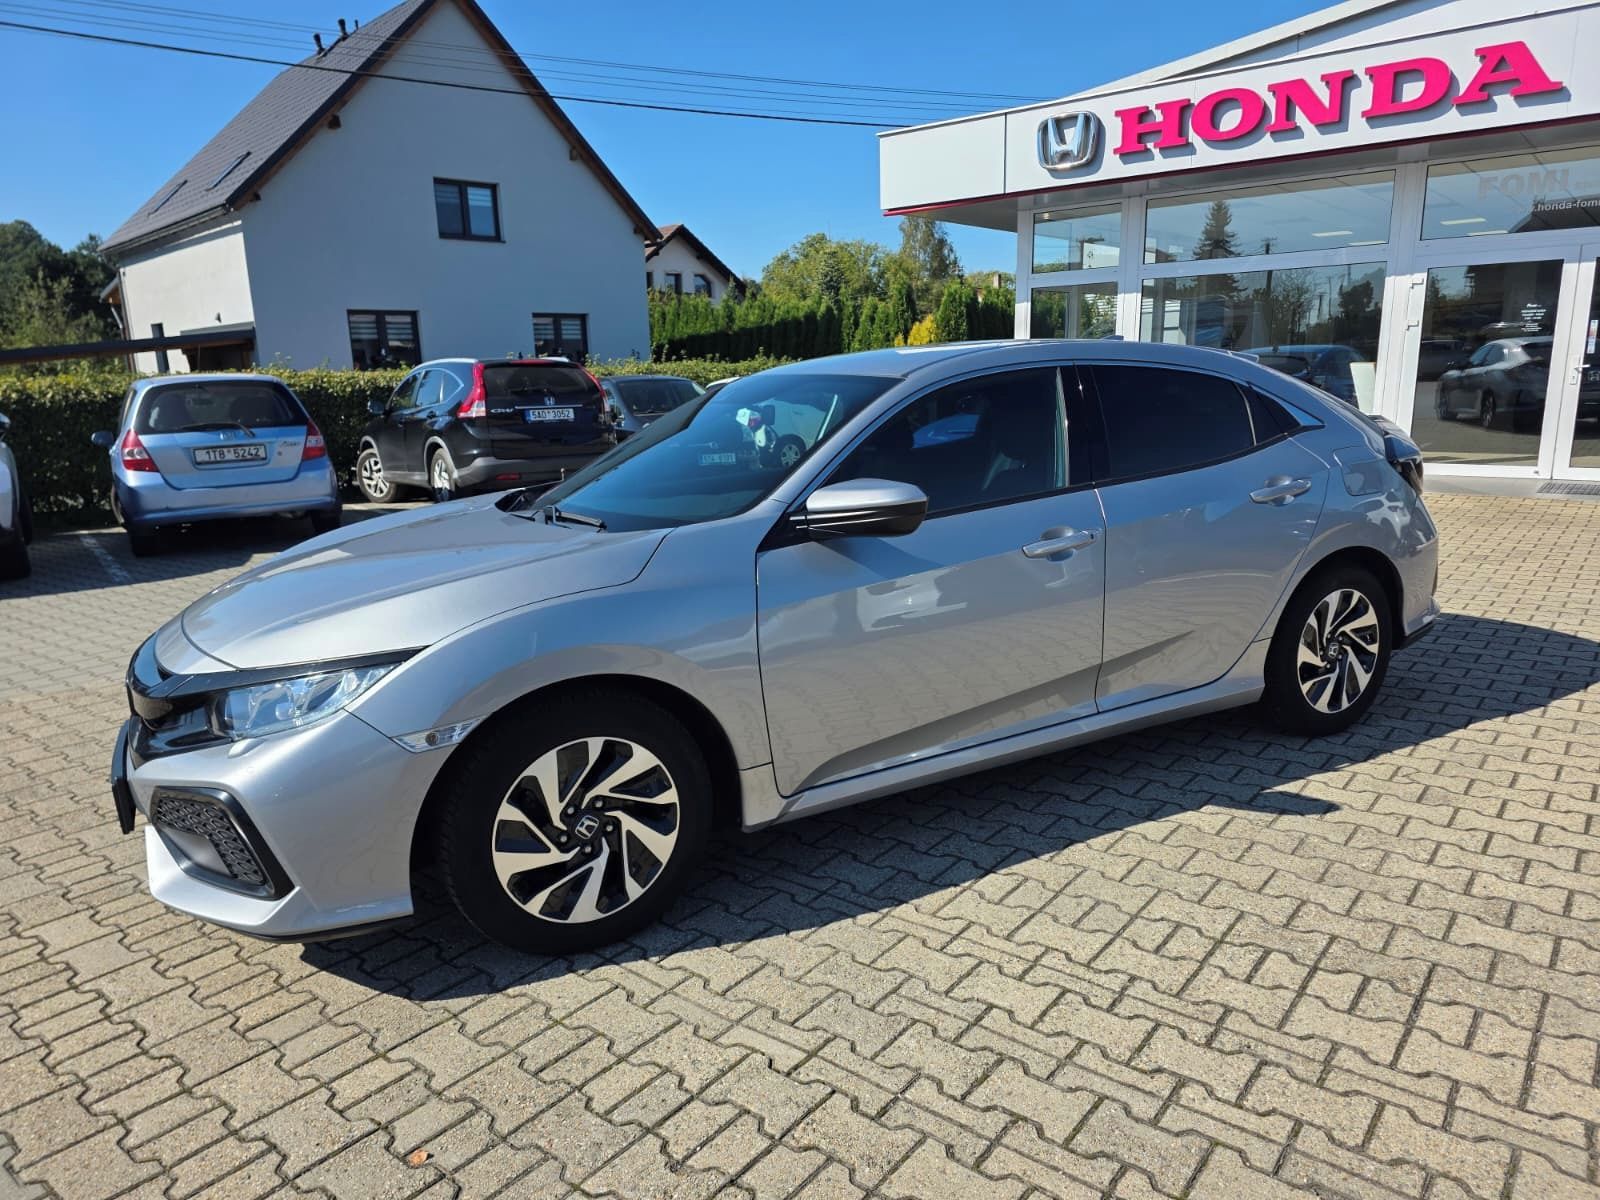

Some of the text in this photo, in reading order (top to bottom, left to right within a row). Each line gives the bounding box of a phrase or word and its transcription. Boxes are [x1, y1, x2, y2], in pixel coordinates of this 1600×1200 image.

[1113, 40, 1564, 155] HONDA
[1478, 168, 1569, 200] FOMI
[233, 447, 261, 458] 5242
